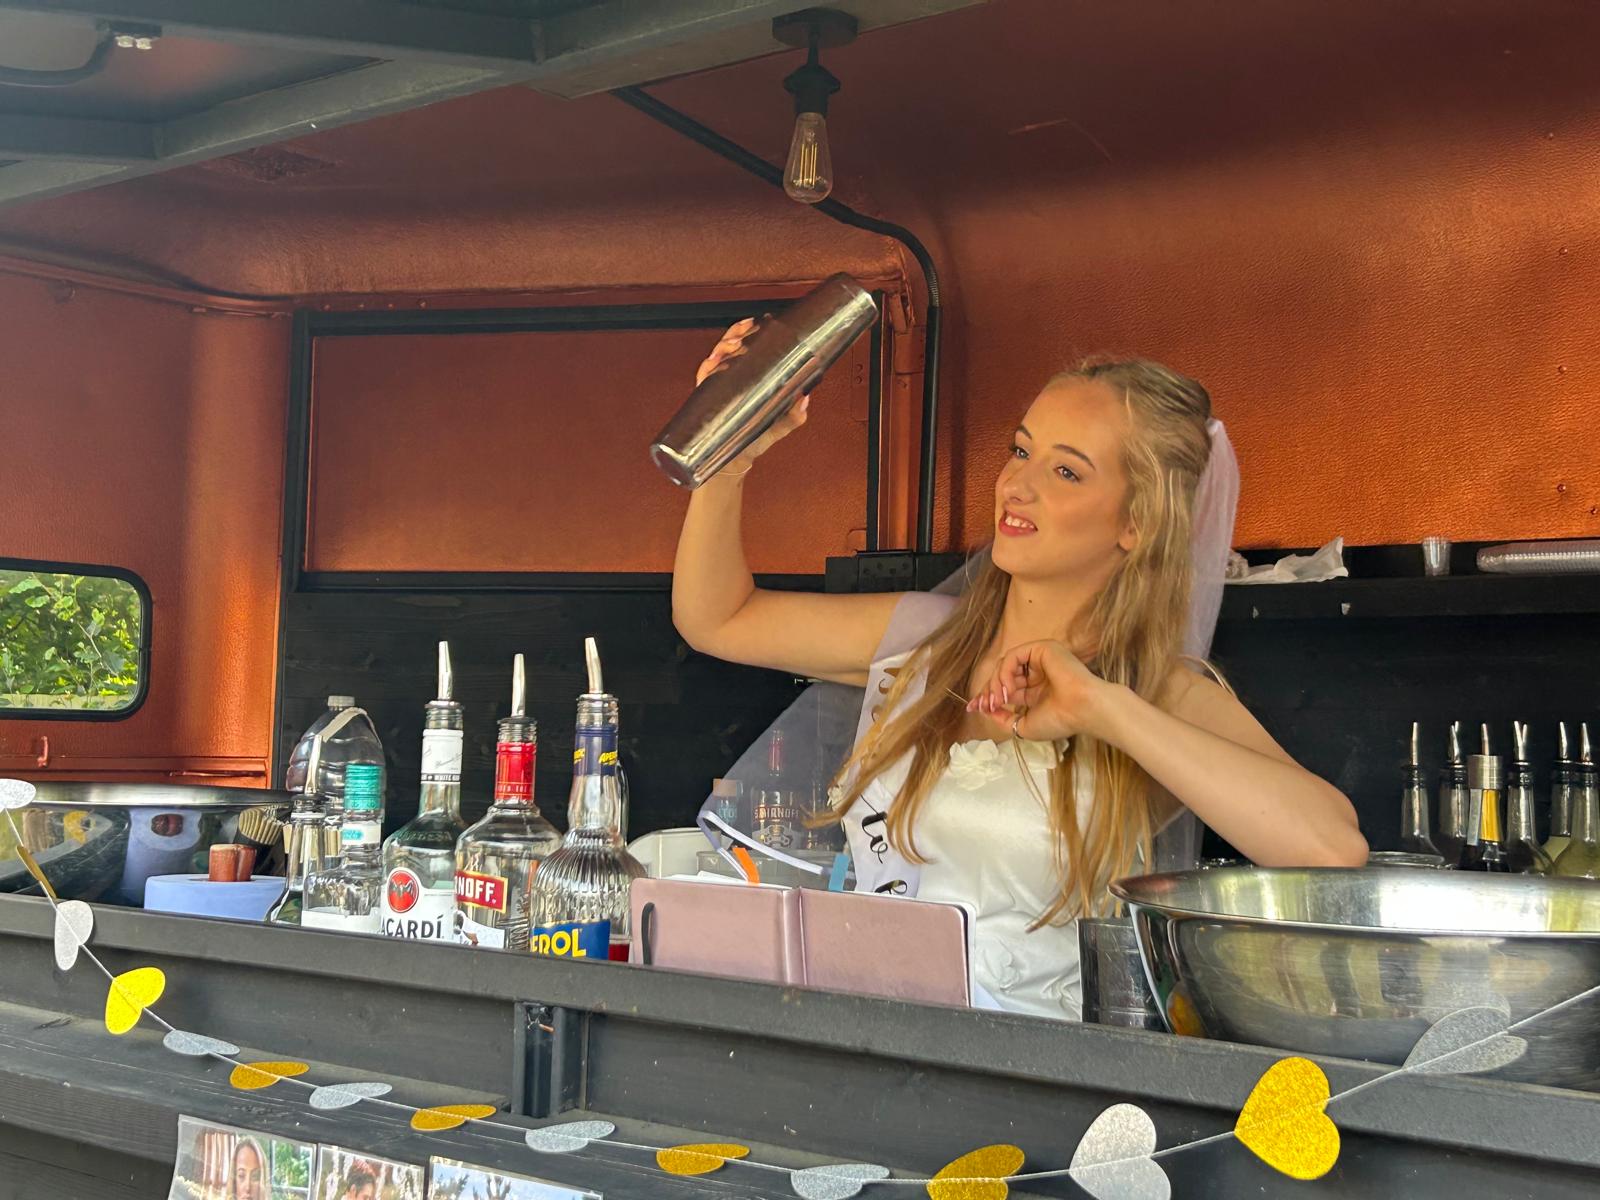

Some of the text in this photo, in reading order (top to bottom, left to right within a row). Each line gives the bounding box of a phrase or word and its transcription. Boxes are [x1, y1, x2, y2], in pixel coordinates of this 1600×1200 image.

[455, 876, 495, 902] NOFF
[380, 914, 443, 939] ACARDÍ
[530, 928, 587, 957] EROL
